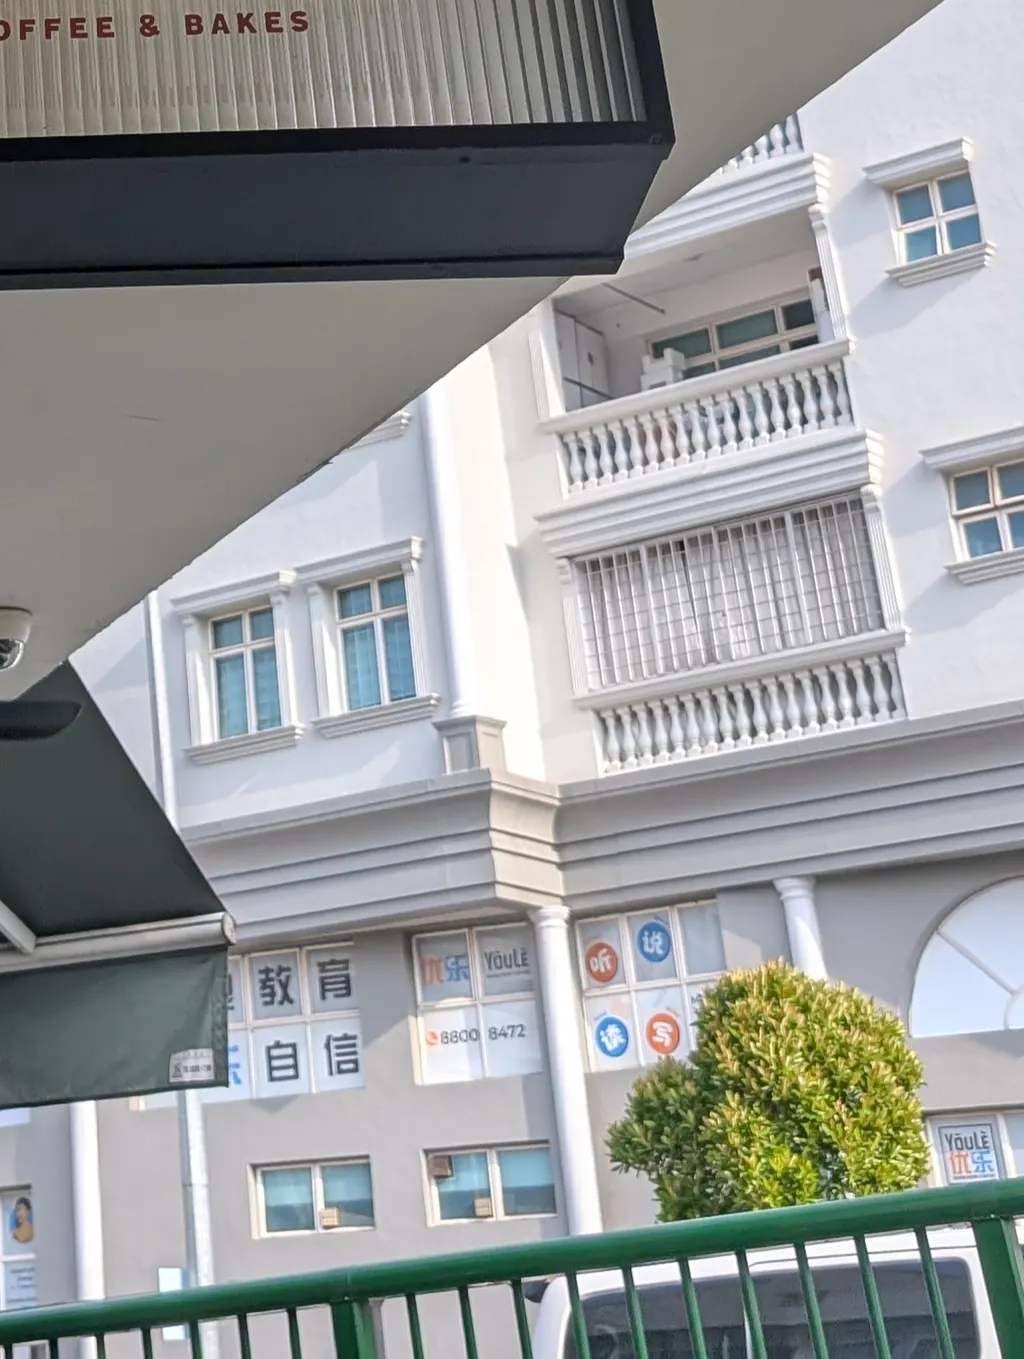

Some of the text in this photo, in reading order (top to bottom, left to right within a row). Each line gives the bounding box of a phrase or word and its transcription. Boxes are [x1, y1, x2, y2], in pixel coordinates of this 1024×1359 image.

[140, 14, 160, 37] &
[184, 10, 309, 36] BAKES
[440, 1023, 527, 1045] 8800 8472
